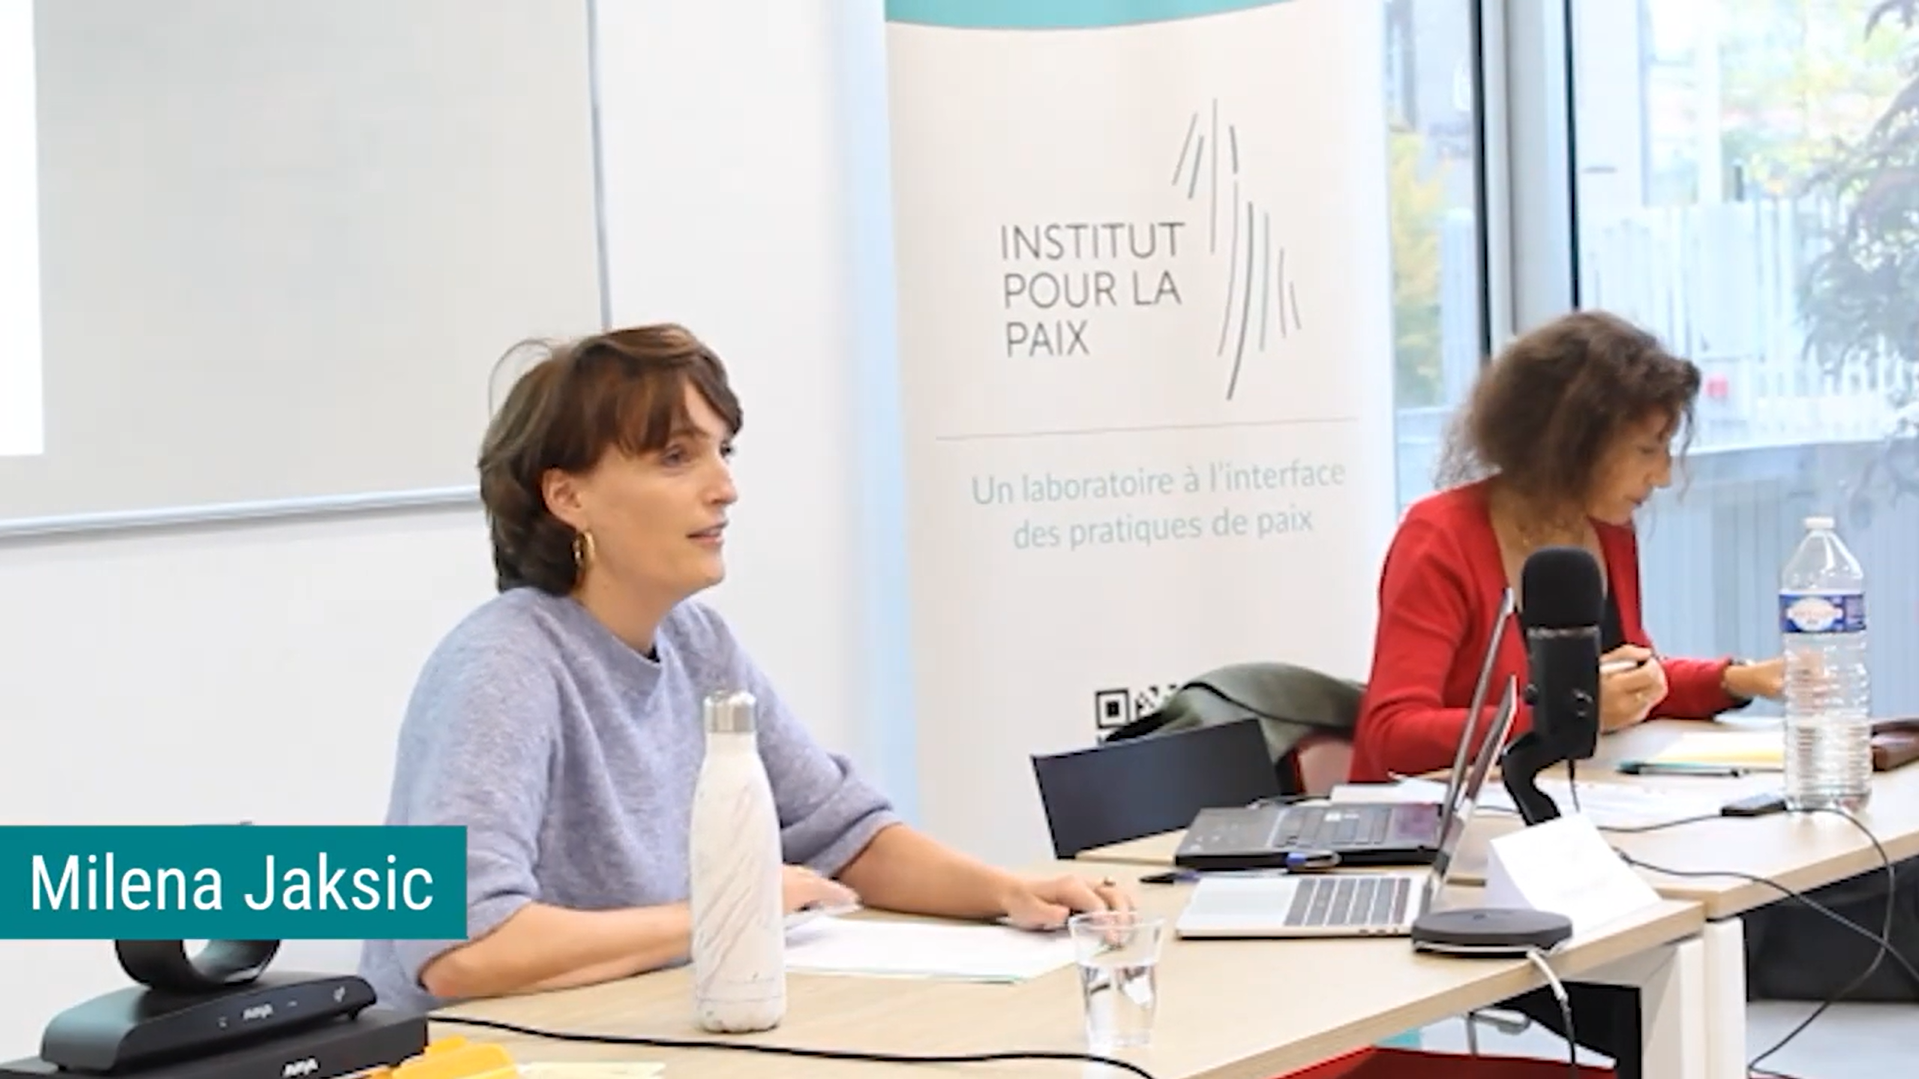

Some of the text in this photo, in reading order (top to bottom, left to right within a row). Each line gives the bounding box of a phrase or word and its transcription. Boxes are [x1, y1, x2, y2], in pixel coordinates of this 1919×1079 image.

[1001, 222, 1186, 261] INSTITUT
[1003, 270, 1182, 309] POUR LA
[1005, 320, 1090, 358] PAIX
[971, 458, 1346, 505] Un laboratoire à l'interface
[1013, 504, 1314, 552] des pratiques de paix
